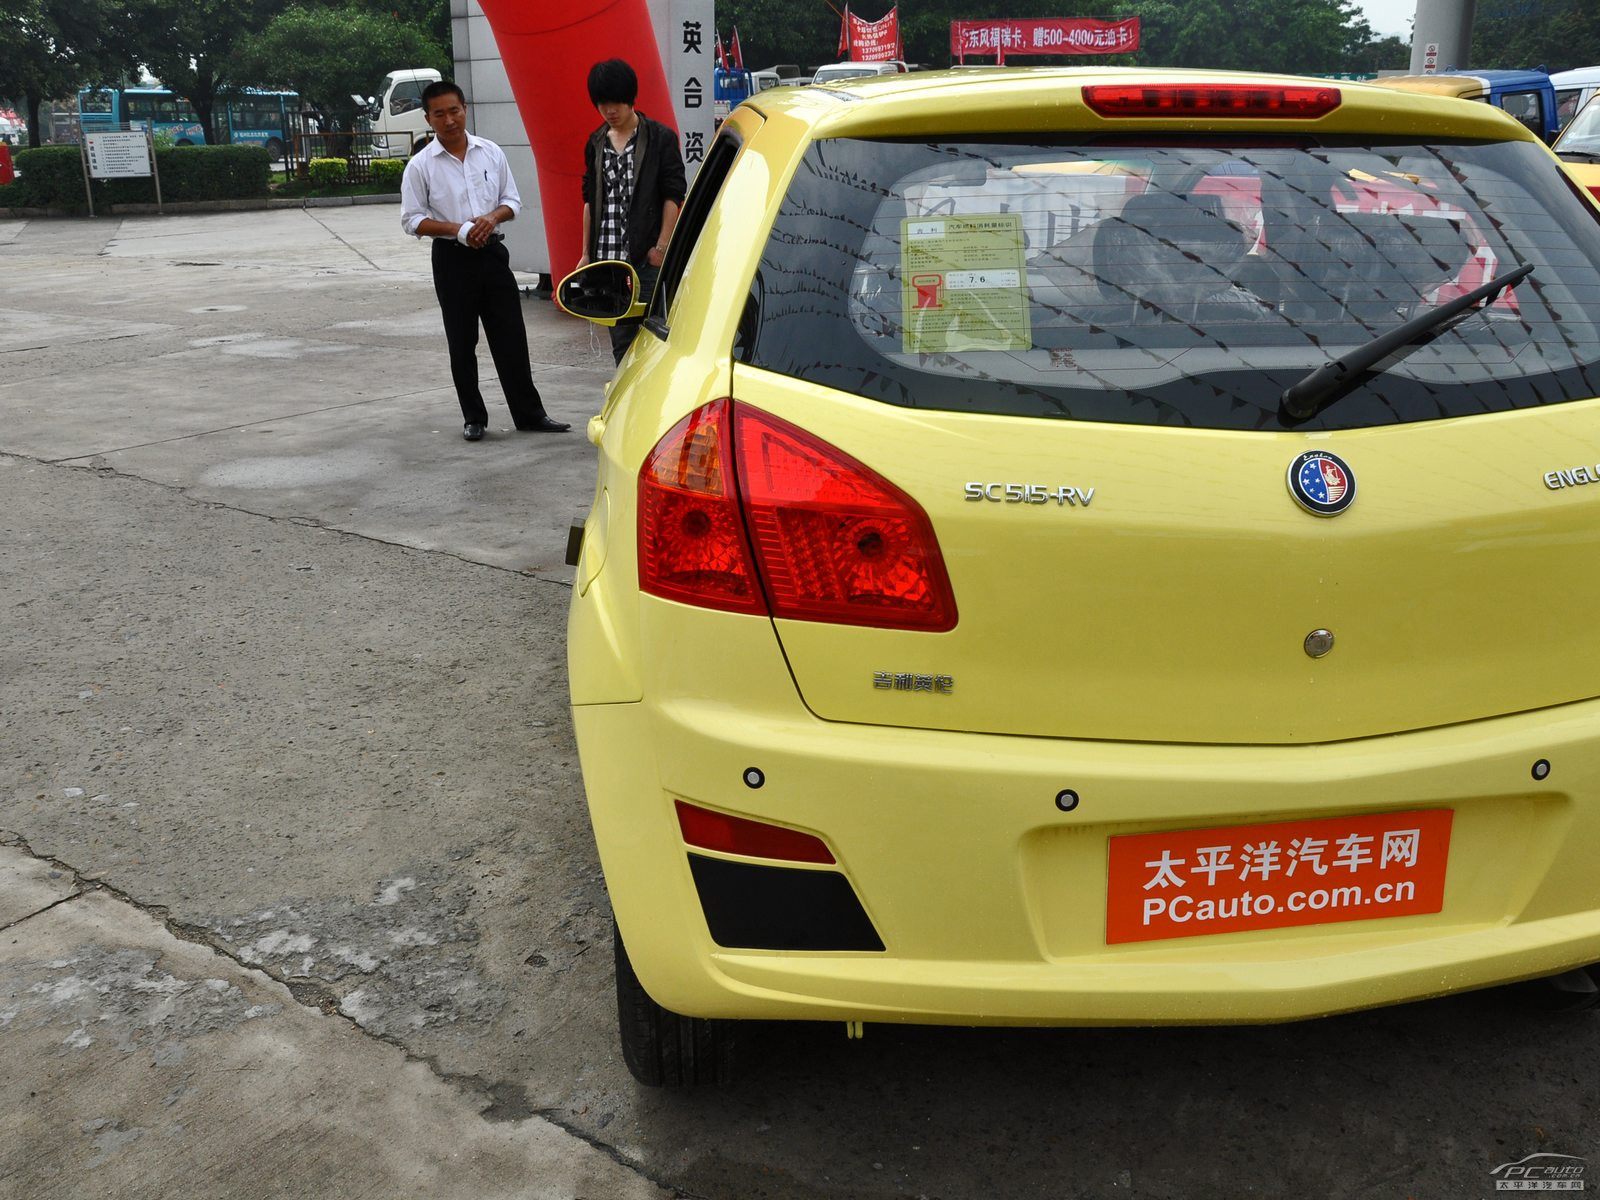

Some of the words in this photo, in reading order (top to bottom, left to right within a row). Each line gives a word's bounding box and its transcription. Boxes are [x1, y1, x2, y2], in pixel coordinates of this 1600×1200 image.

[682, 20, 704, 164] 英合资
[1143, 829, 1420, 891] 太平洋汽车网
[1143, 880, 1416, 926] PCauto.com.cn
